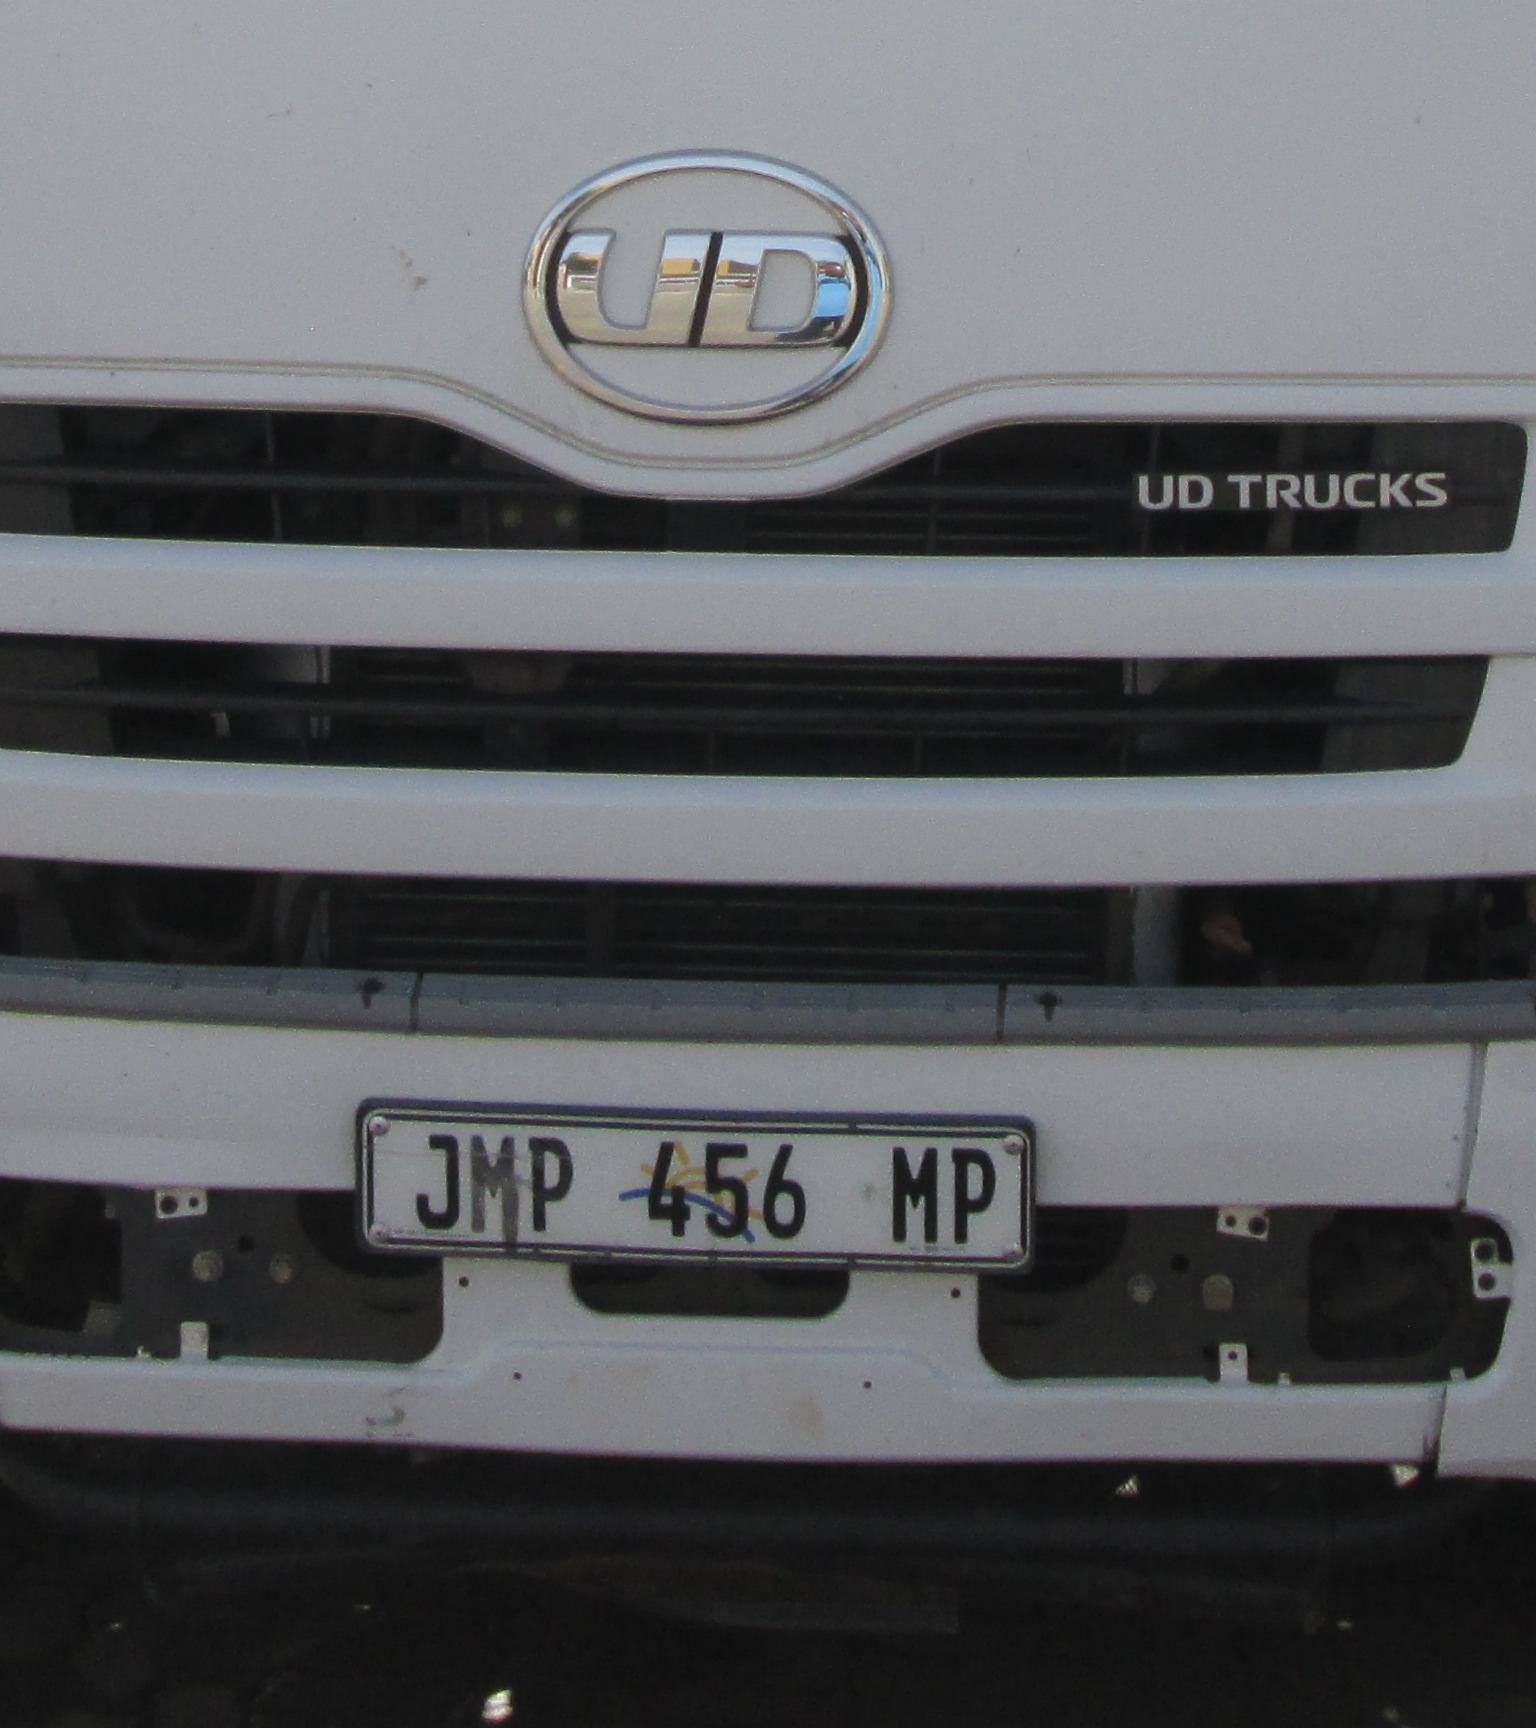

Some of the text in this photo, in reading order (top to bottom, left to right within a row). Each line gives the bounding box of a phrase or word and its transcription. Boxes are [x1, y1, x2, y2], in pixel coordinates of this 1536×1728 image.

[556, 228, 860, 348] UD
[1137, 472, 1448, 510] UD TRUCKS
[416, 1134, 997, 1245] JMP 456 MP
